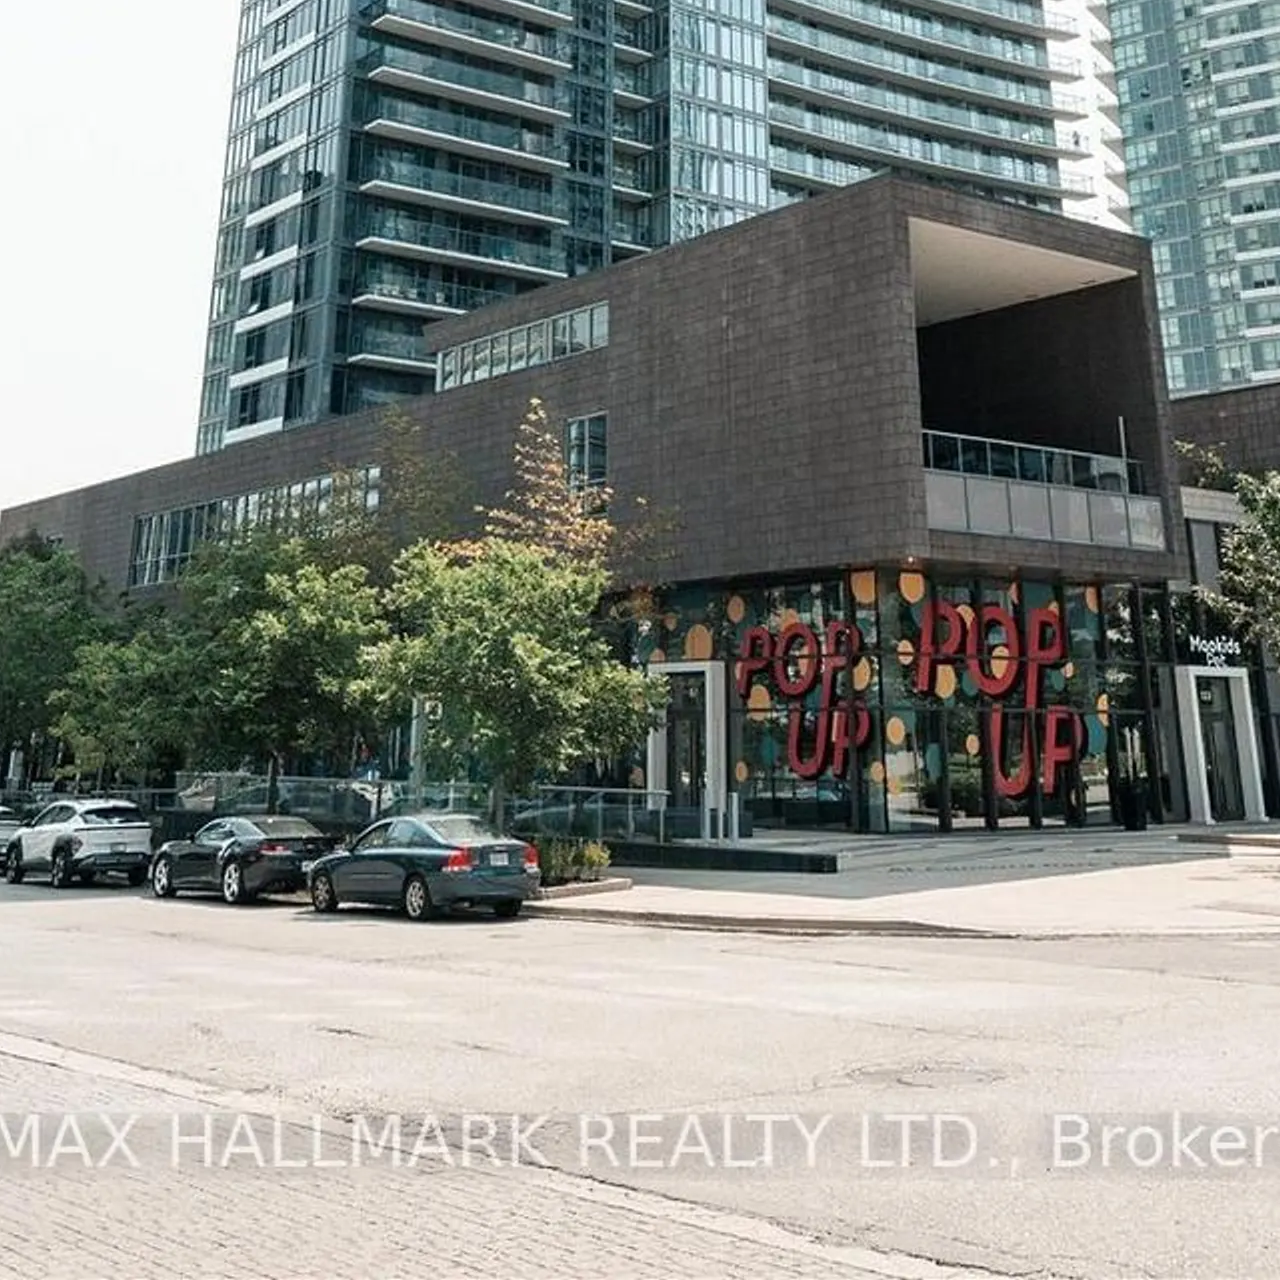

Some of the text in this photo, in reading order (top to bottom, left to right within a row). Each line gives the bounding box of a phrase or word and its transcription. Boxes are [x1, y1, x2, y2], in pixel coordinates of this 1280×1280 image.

[735, 621, 860, 702] POP
[914, 599, 1066, 709] POP
[787, 700, 870, 778] UP
[988, 703, 1088, 796] UP
